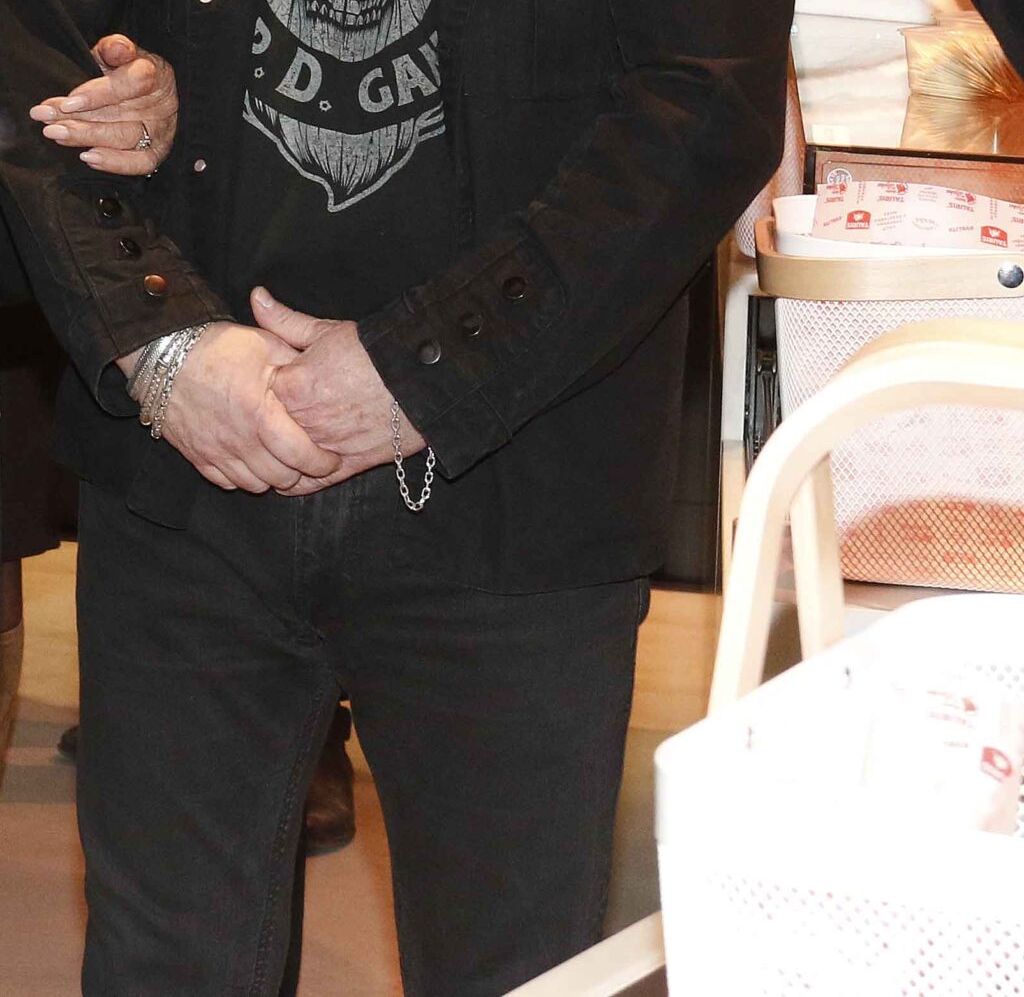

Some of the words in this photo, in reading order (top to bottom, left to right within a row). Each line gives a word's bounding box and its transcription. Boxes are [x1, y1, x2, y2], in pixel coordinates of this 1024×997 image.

[878, 195, 905, 203] TAURIS
[949, 202, 975, 213] TAURIS
[846, 221, 871, 229] TAURIS
[981, 235, 1008, 248] TAURIS
